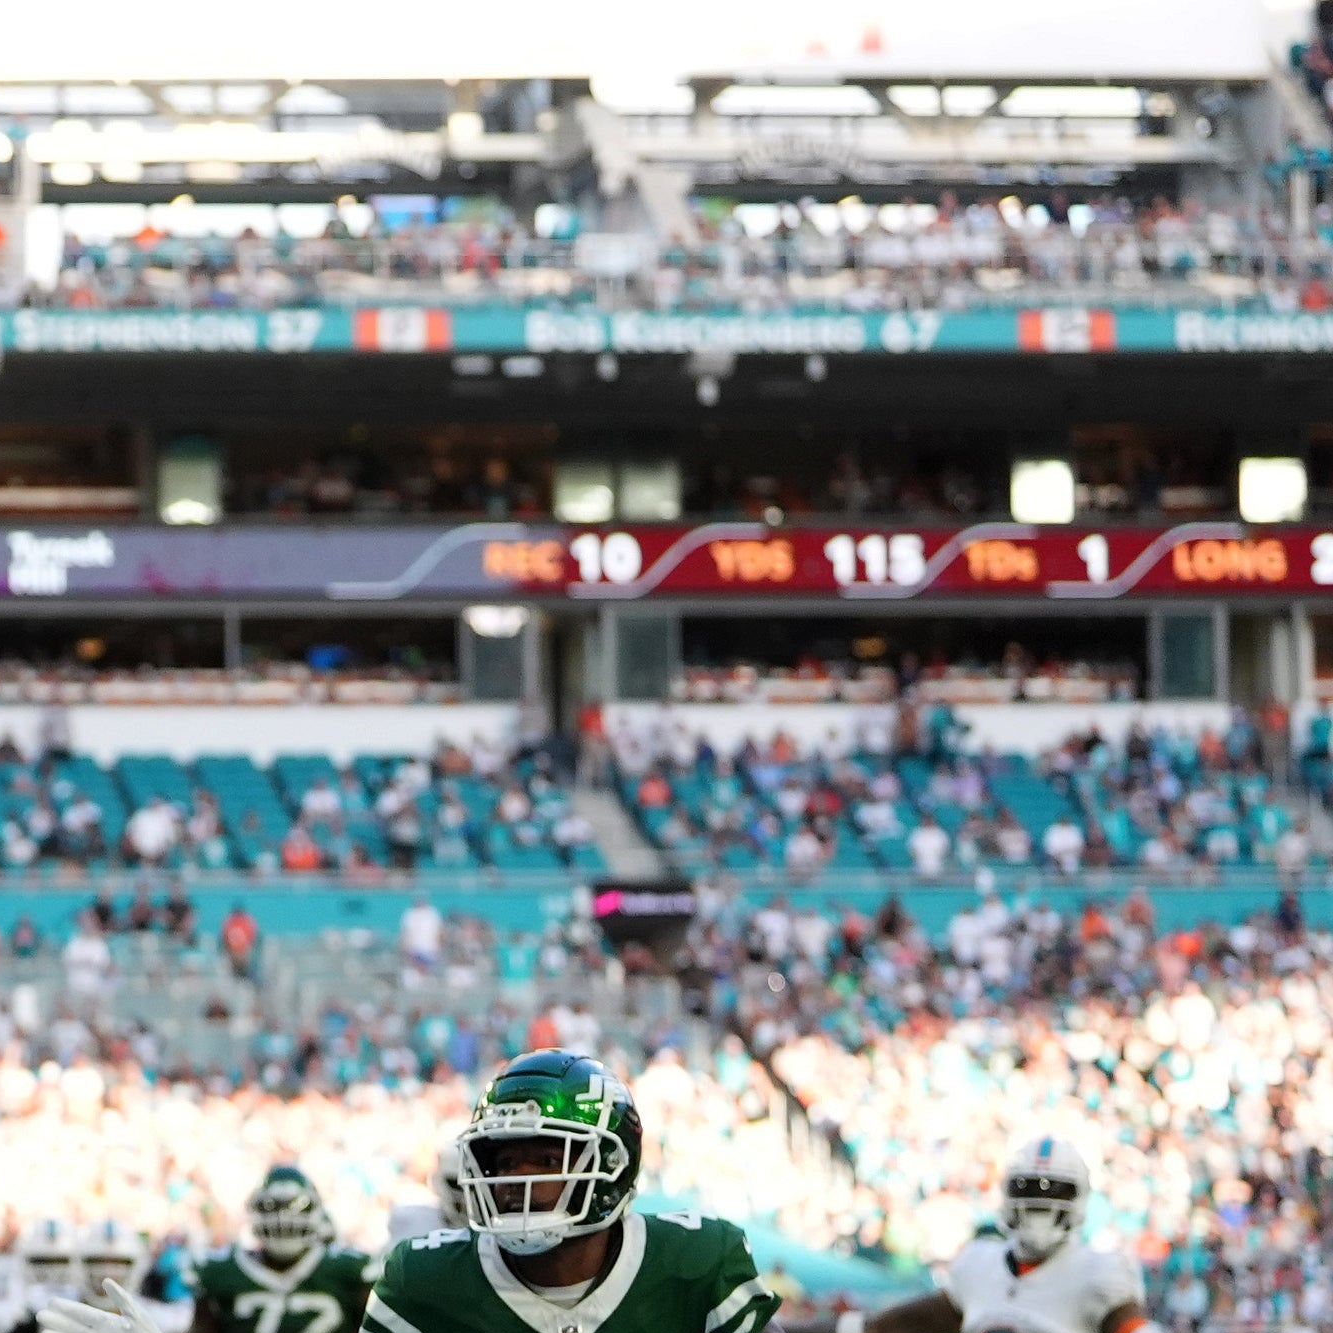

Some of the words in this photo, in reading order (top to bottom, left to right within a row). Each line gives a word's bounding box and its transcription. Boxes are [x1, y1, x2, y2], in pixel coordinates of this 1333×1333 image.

[482, 540, 565, 582] REC
[570, 531, 642, 585] 10
[709, 540, 795, 582] YDS
[824, 533, 928, 586] 115
[966, 539, 1040, 582] TDs
[1078, 534, 1110, 584] 1
[1172, 538, 1288, 583] LONG
